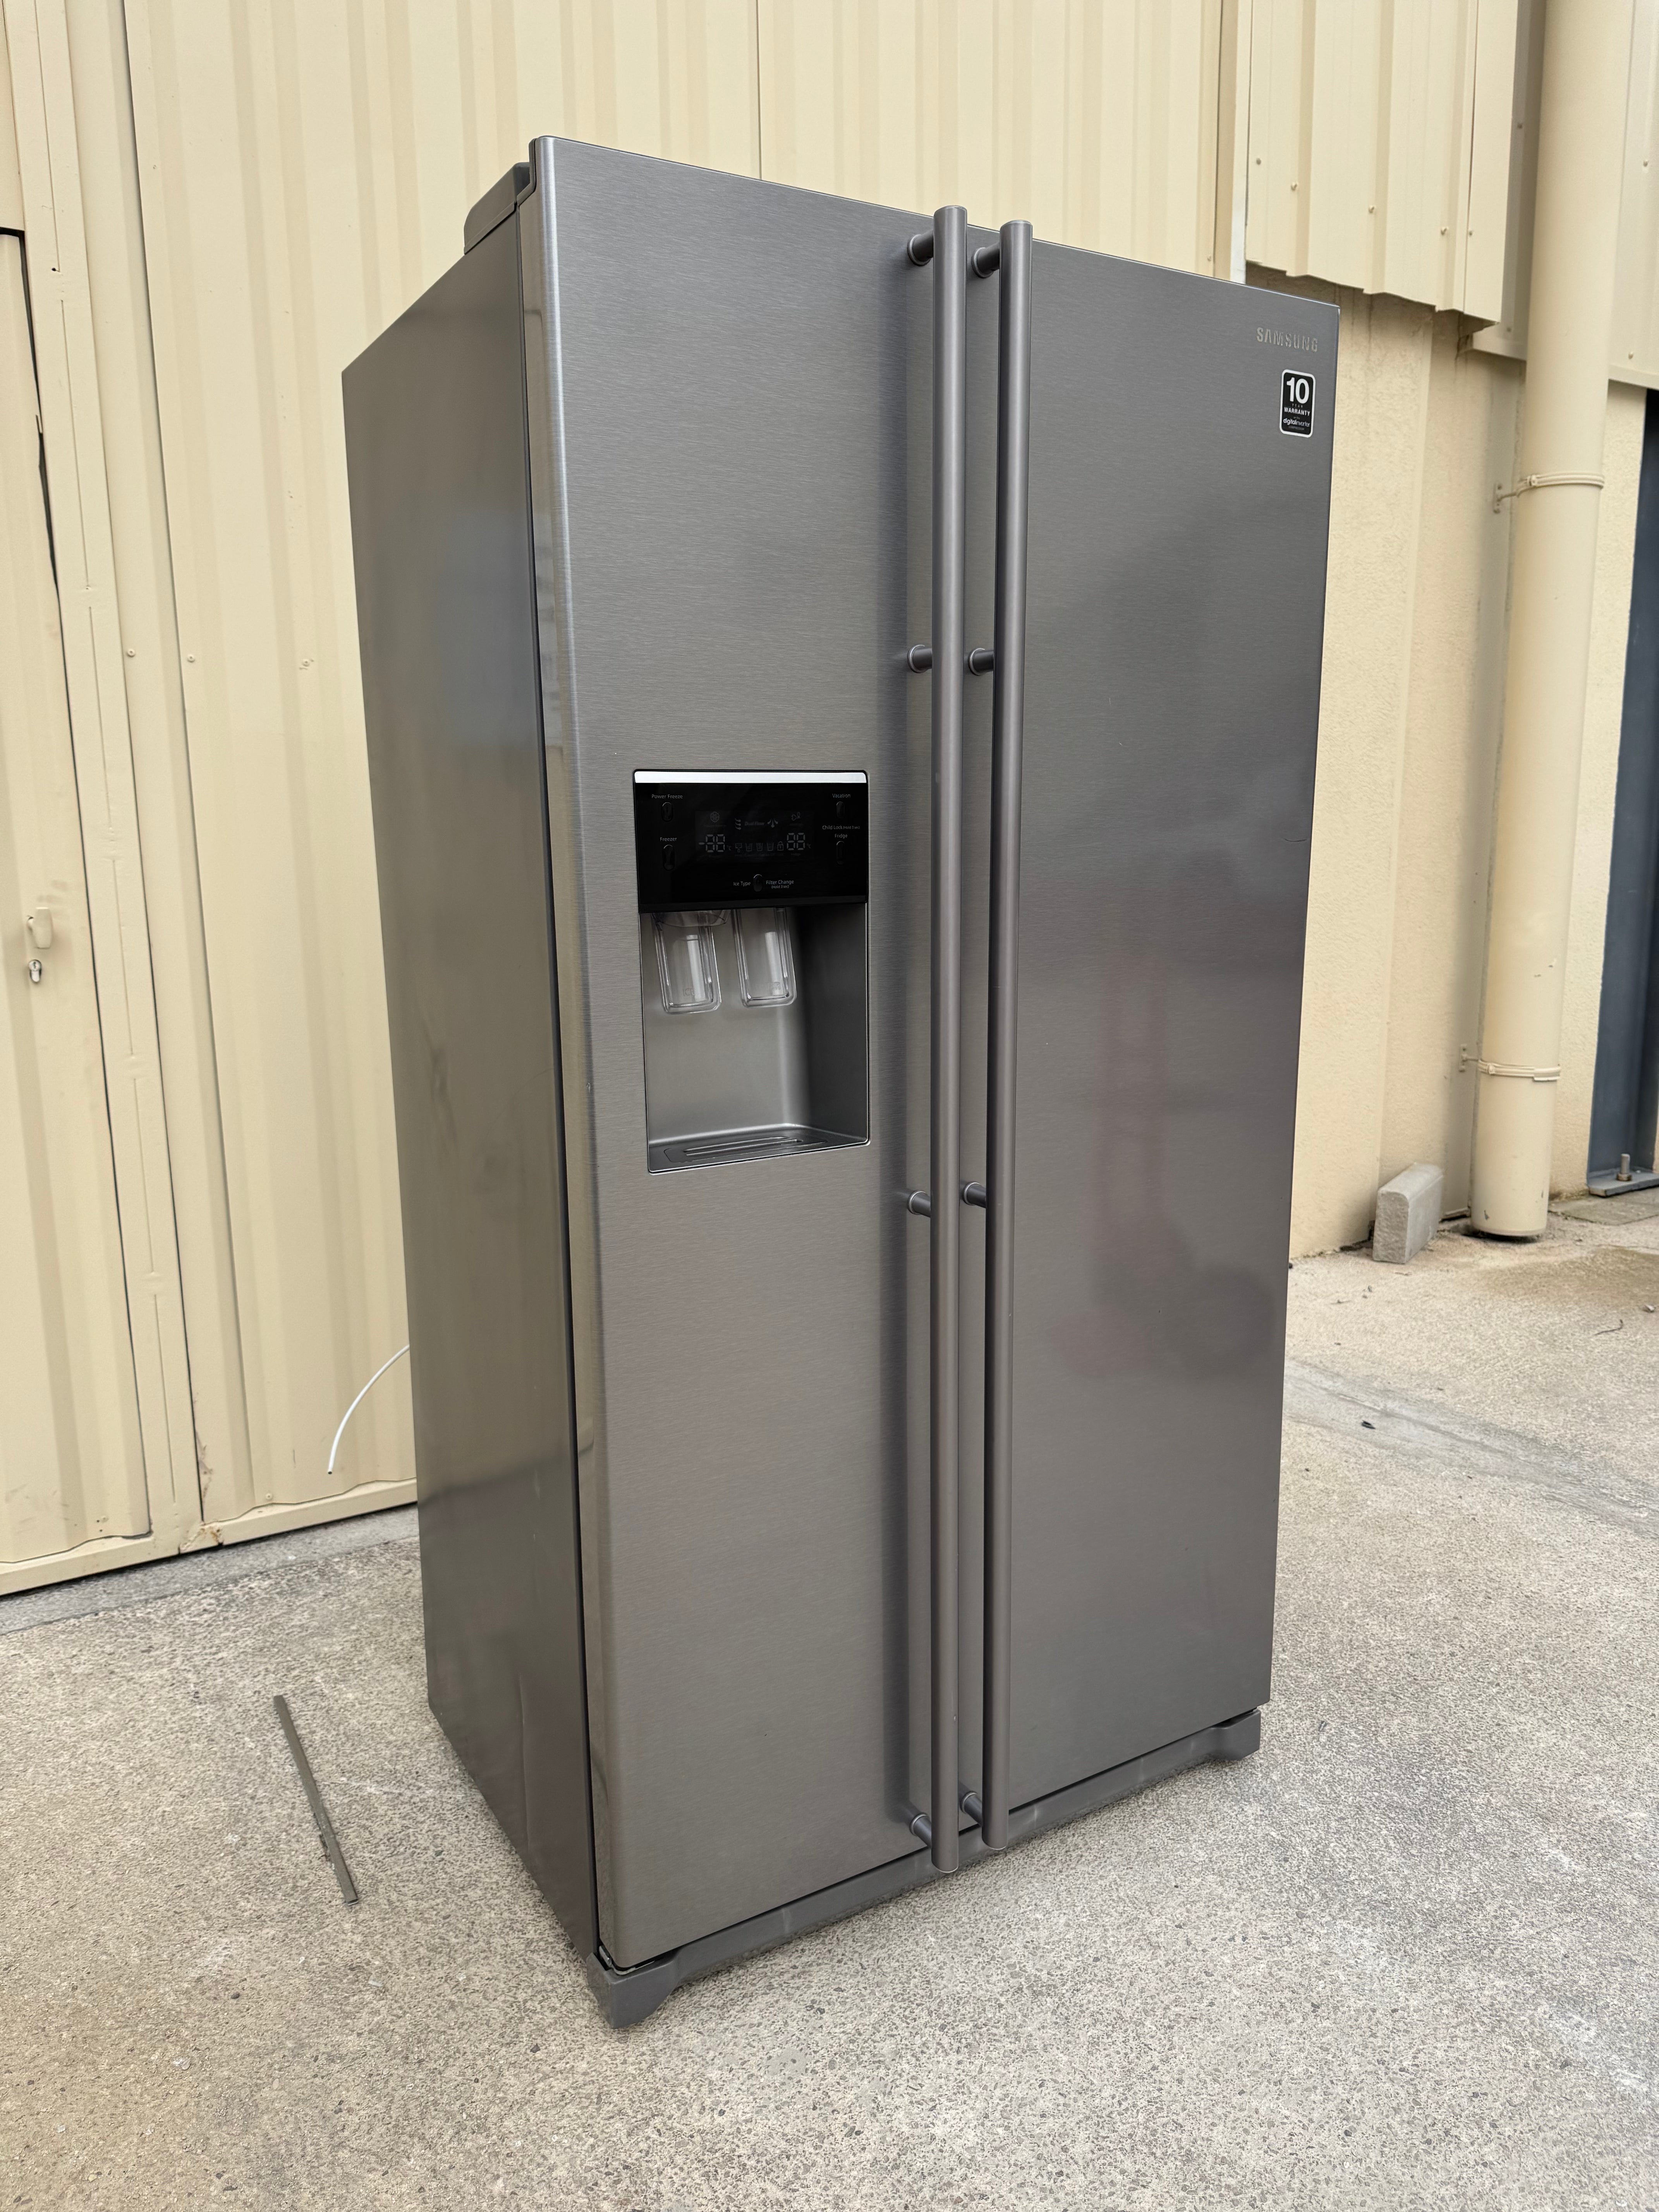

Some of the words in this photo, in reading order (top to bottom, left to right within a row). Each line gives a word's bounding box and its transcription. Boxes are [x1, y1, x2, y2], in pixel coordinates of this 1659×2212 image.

[1257, 327, 1318, 352] SAMSUNG
[1286, 377, 1309, 404] 10
[1284, 407, 1310, 416] WARRANTY
[787, 833, 805, 851] 88
